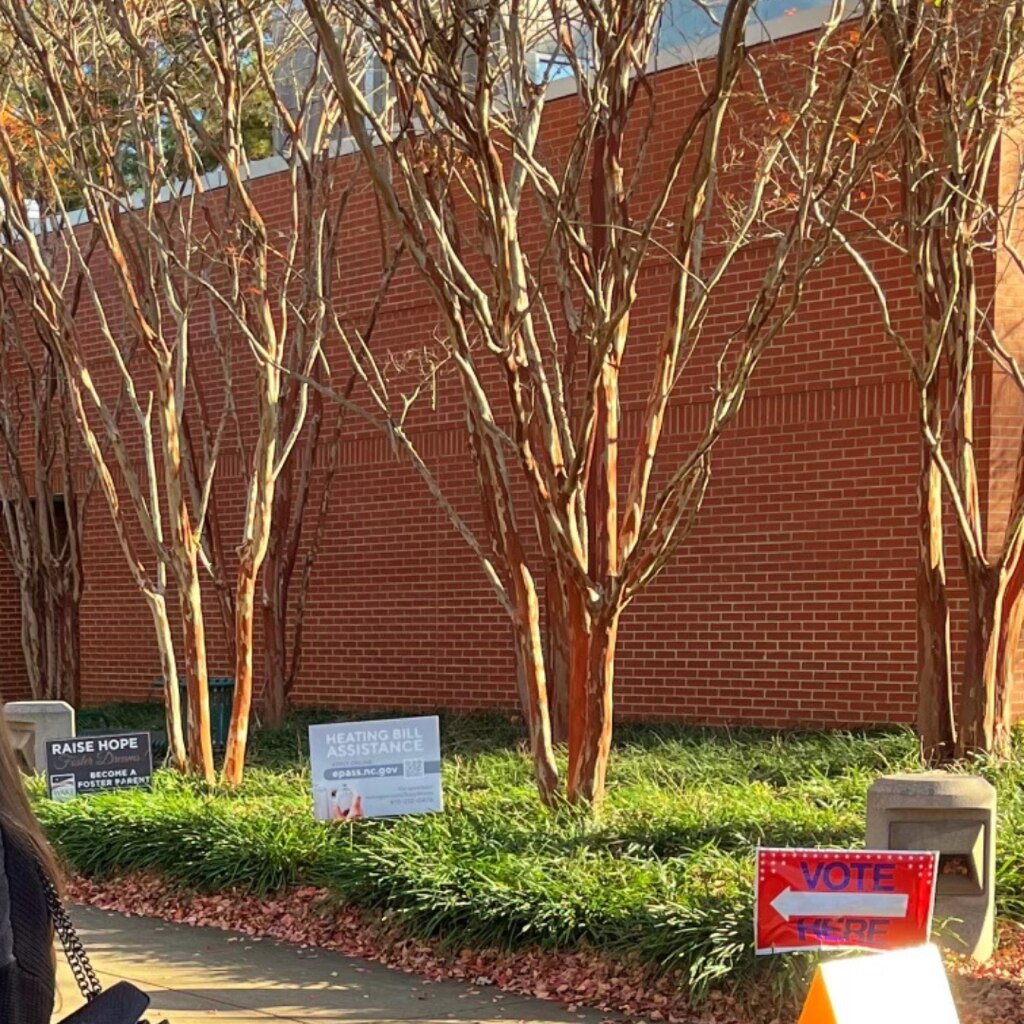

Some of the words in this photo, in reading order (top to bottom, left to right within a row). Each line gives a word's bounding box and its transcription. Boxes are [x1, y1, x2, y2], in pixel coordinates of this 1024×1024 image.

[325, 729, 389, 745] HEATING
[393, 727, 423, 740] BILL
[52, 741, 94, 755] RAISE
[98, 738, 138, 751] HOPE
[327, 740, 424, 758] ASSISTANCE
[90, 769, 127, 779] BECOME
[332, 766, 398, 779] epass.nc.gov
[77, 779, 113, 789] FOSTER
[114, 776, 150, 786] PARENT
[800, 861, 896, 892] VOTE
[796, 918, 890, 944] HERE
